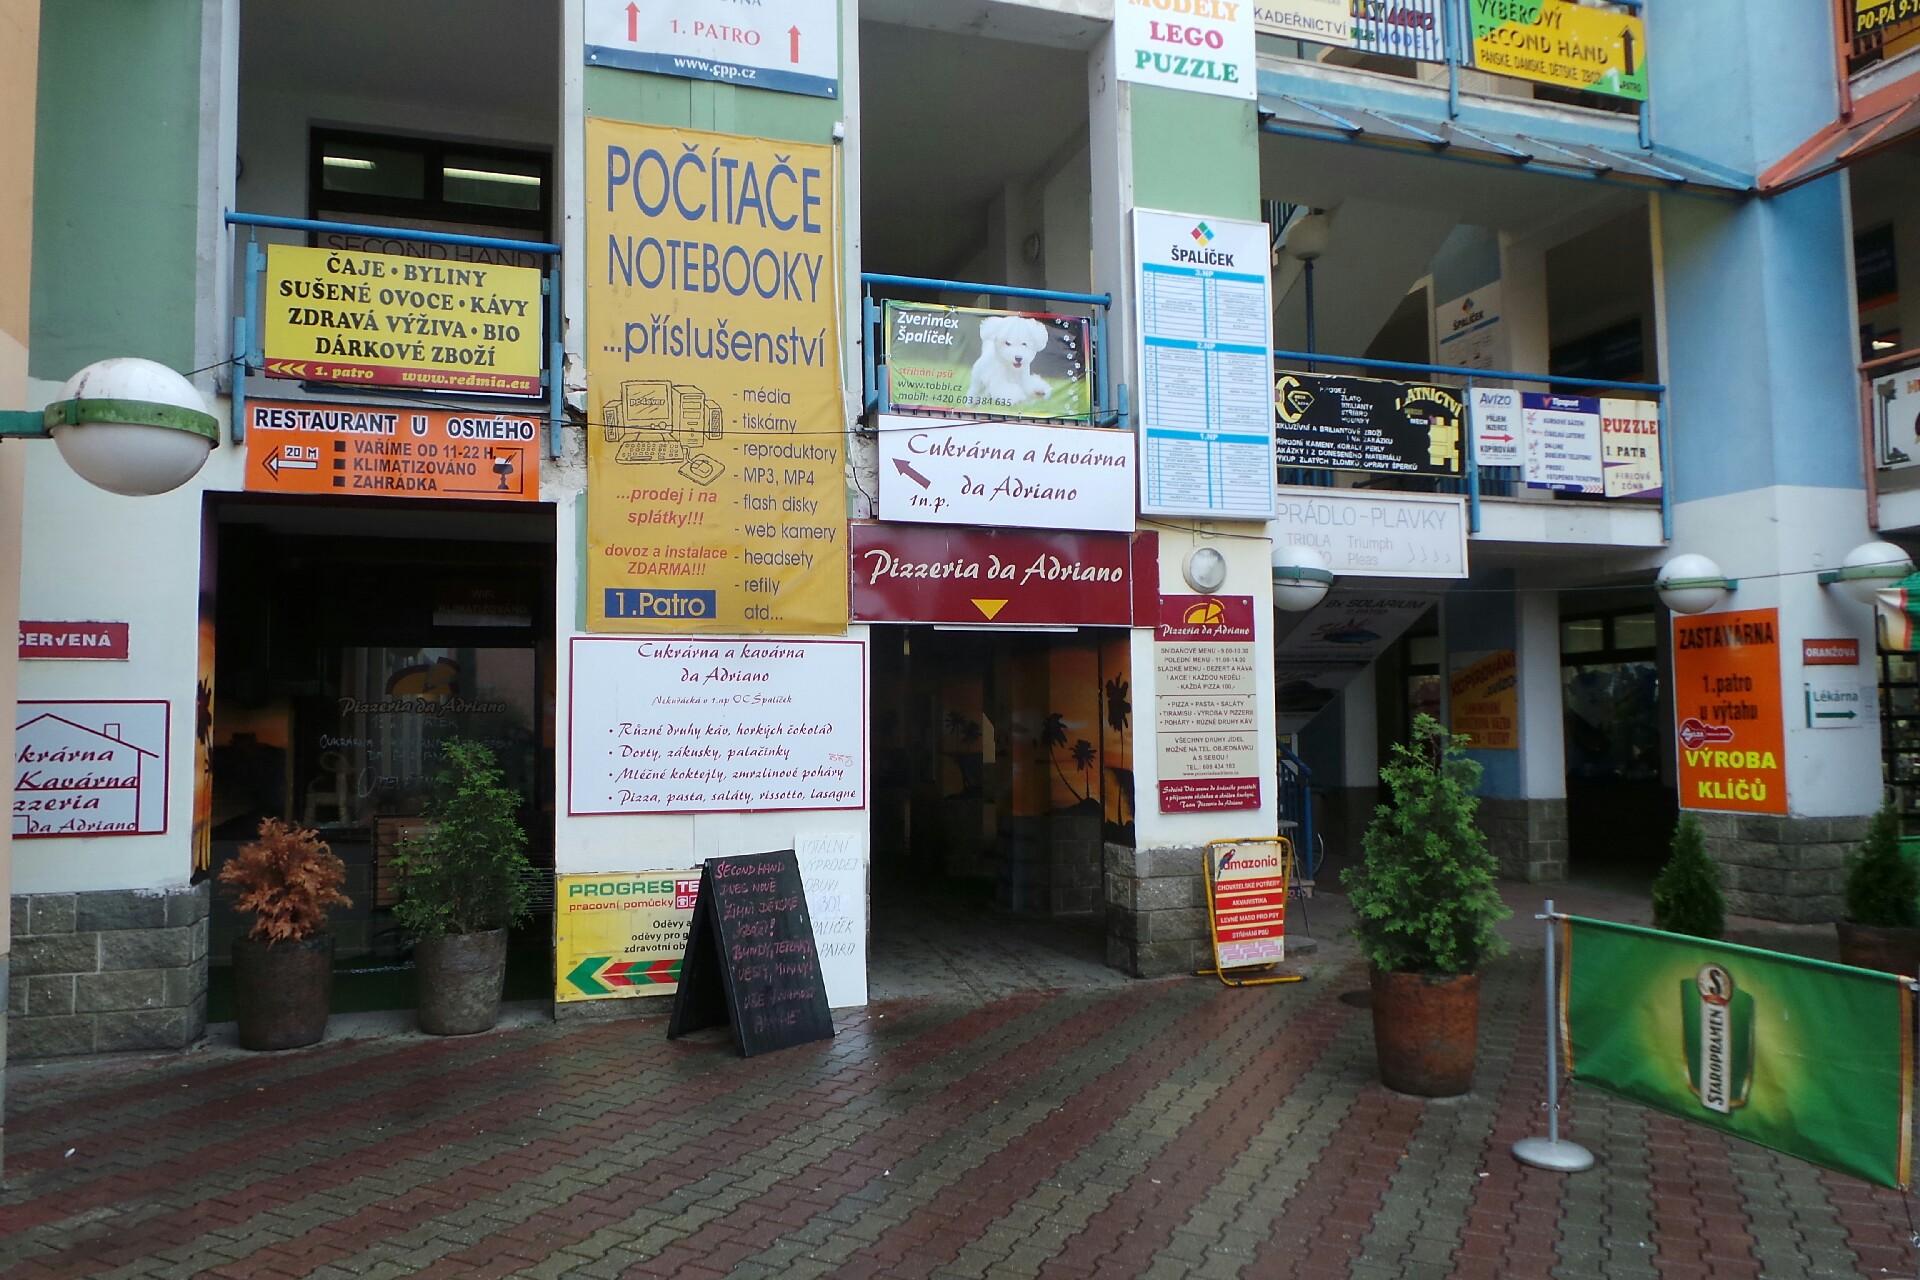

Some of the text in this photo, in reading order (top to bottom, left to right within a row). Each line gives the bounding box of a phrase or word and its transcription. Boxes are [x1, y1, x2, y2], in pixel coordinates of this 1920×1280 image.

[1255, 7, 1347, 35] KADEŘNICTVÍ
[671, 20, 760, 46] 1. PATRO
[1150, 21, 1224, 49] LEGO
[1479, 24, 1608, 64] SECOND HAND
[674, 58, 756, 79] www.cpp.cz
[1135, 50, 1239, 83] PUZZLE
[608, 142, 820, 233] POČÍTAČE
[1171, 245, 1234, 267] ŠPALÍČEK
[327, 252, 487, 287] ČAJE BYLINY
[609, 234, 823, 302] NOTEBOOKY
[280, 279, 528, 317] SUŠENÉ OVOCE KÁVY
[288, 307, 520, 342] ZDRAVÁ VÝŽIVA BIO
[898, 311, 959, 329] Zverimex
[603, 313, 826, 366] ...příslušenství
[898, 326, 953, 347] Špalíček
[315, 335, 495, 366] DÁRKOVÉ ZBOŽÍ
[315, 367, 530, 390] 1. patro www.redmia.eu
[898, 367, 953, 379] stříhání psů
[898, 381, 962, 391] www.tobbi.cz
[743, 388, 790, 404] média
[898, 391, 1012, 406] mobil: +420 603 384 635
[254, 408, 535, 440] RESTAURANT U OSMÉHO
[743, 413, 797, 433] tiskárny
[1603, 418, 1656, 435] PUZZLE
[285, 447, 318, 458] 20 M
[354, 438, 412, 457] VAŘÍME
[418, 443, 438, 458] OD
[443, 444, 479, 459] 11-22
[743, 443, 836, 463] reproduktory
[907, 433, 1126, 468] Cukrárna a kavárna
[354, 457, 476, 476] KLIMATIZOVÁNO
[352, 474, 437, 491] ZAHRÁDKA
[744, 469, 814, 485] MP3, MP4
[689, 488, 693, 500] i
[698, 491, 717, 502] na
[961, 475, 1078, 501] da Adriano
[744, 494, 818, 515] flash disky
[628, 510, 703, 528] splátky!!!
[745, 524, 836, 542] web kamery
[605, 544, 727, 559] dovoz a instalace
[1287, 533, 1393, 552] TRIOLA Triumph
[744, 550, 813, 568] headsety
[865, 549, 1123, 586] Pizzeria da Adriano
[1348, 553, 1378, 565] Pleas
[627, 562, 705, 575] ZDARMA!!!
[744, 578, 780, 595] refily
[616, 592, 706, 617] 1.Patro
[744, 604, 783, 621] atd...
[1161, 624, 1249, 637] Pizzeria da Adriano
[1679, 618, 1774, 649] ZASTAVÁRNA
[637, 643, 805, 659] Cukrárna a kavárna
[681, 666, 770, 685] da Adriano
[1813, 690, 1858, 702] Lékárna
[339, 696, 506, 716] Pizzeria da Adriano
[1701, 701, 1758, 724] u výtahu
[619, 723, 832, 739] Různé druhy káv, horkých čokolád
[619, 745, 790, 762] Dorty, zákusky, palačinky
[1685, 748, 1777, 769] VÝROBA
[18, 770, 137, 789] Kavárna
[615, 767, 844, 783] Mléčné koktejly, zmrzlinové poháry
[619, 789, 856, 805] Pizza, pasta, saláty, rissotto, lasagne
[1698, 778, 1767, 800] KLÍČŮ
[30, 818, 136, 833] da Adriano
[715, 861, 785, 879] SECOND HAND
[1224, 855, 1277, 870] amazonia
[1217, 881, 1255, 891] CHOVATELSKÉ
[569, 898, 674, 912] pracovní pomůcky
[1232, 897, 1267, 906] AKVARISTIKA
[653, 919, 684, 929] Oděvy
[1221, 914, 1238, 923] LEVNÉ
[631, 931, 680, 942] oděvy pro
[624, 942, 670, 954] zdravotní
[820, 943, 855, 958] PATRO
[1706, 1008, 1723, 1106] STAROPRAMEN
